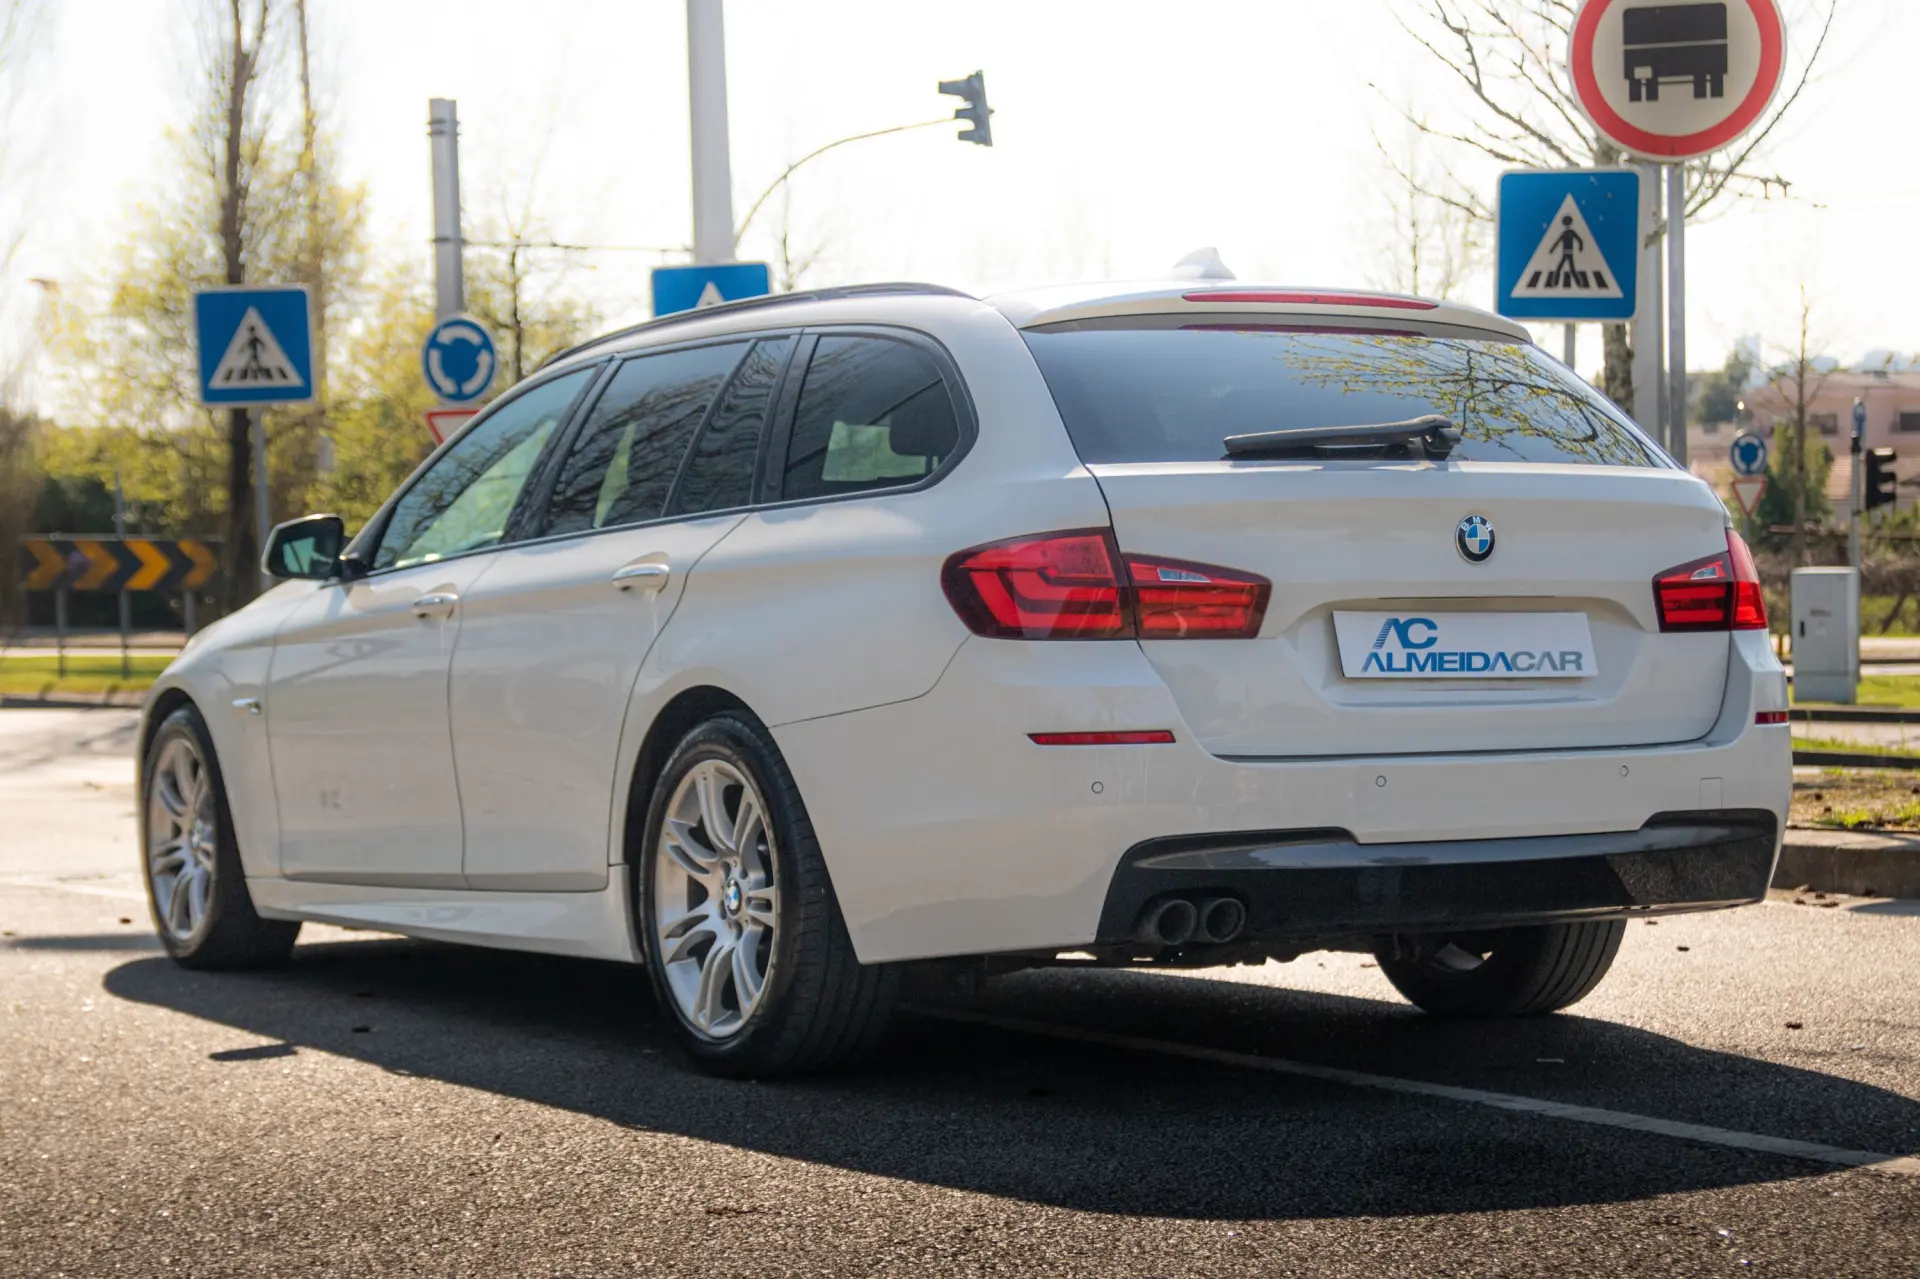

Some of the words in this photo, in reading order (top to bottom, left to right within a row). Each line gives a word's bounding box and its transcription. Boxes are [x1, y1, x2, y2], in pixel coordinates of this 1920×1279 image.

[1460, 516, 1493, 531] BMW
[1372, 617, 1438, 649] AC
[1361, 651, 1583, 673] ALMEIDACAR
